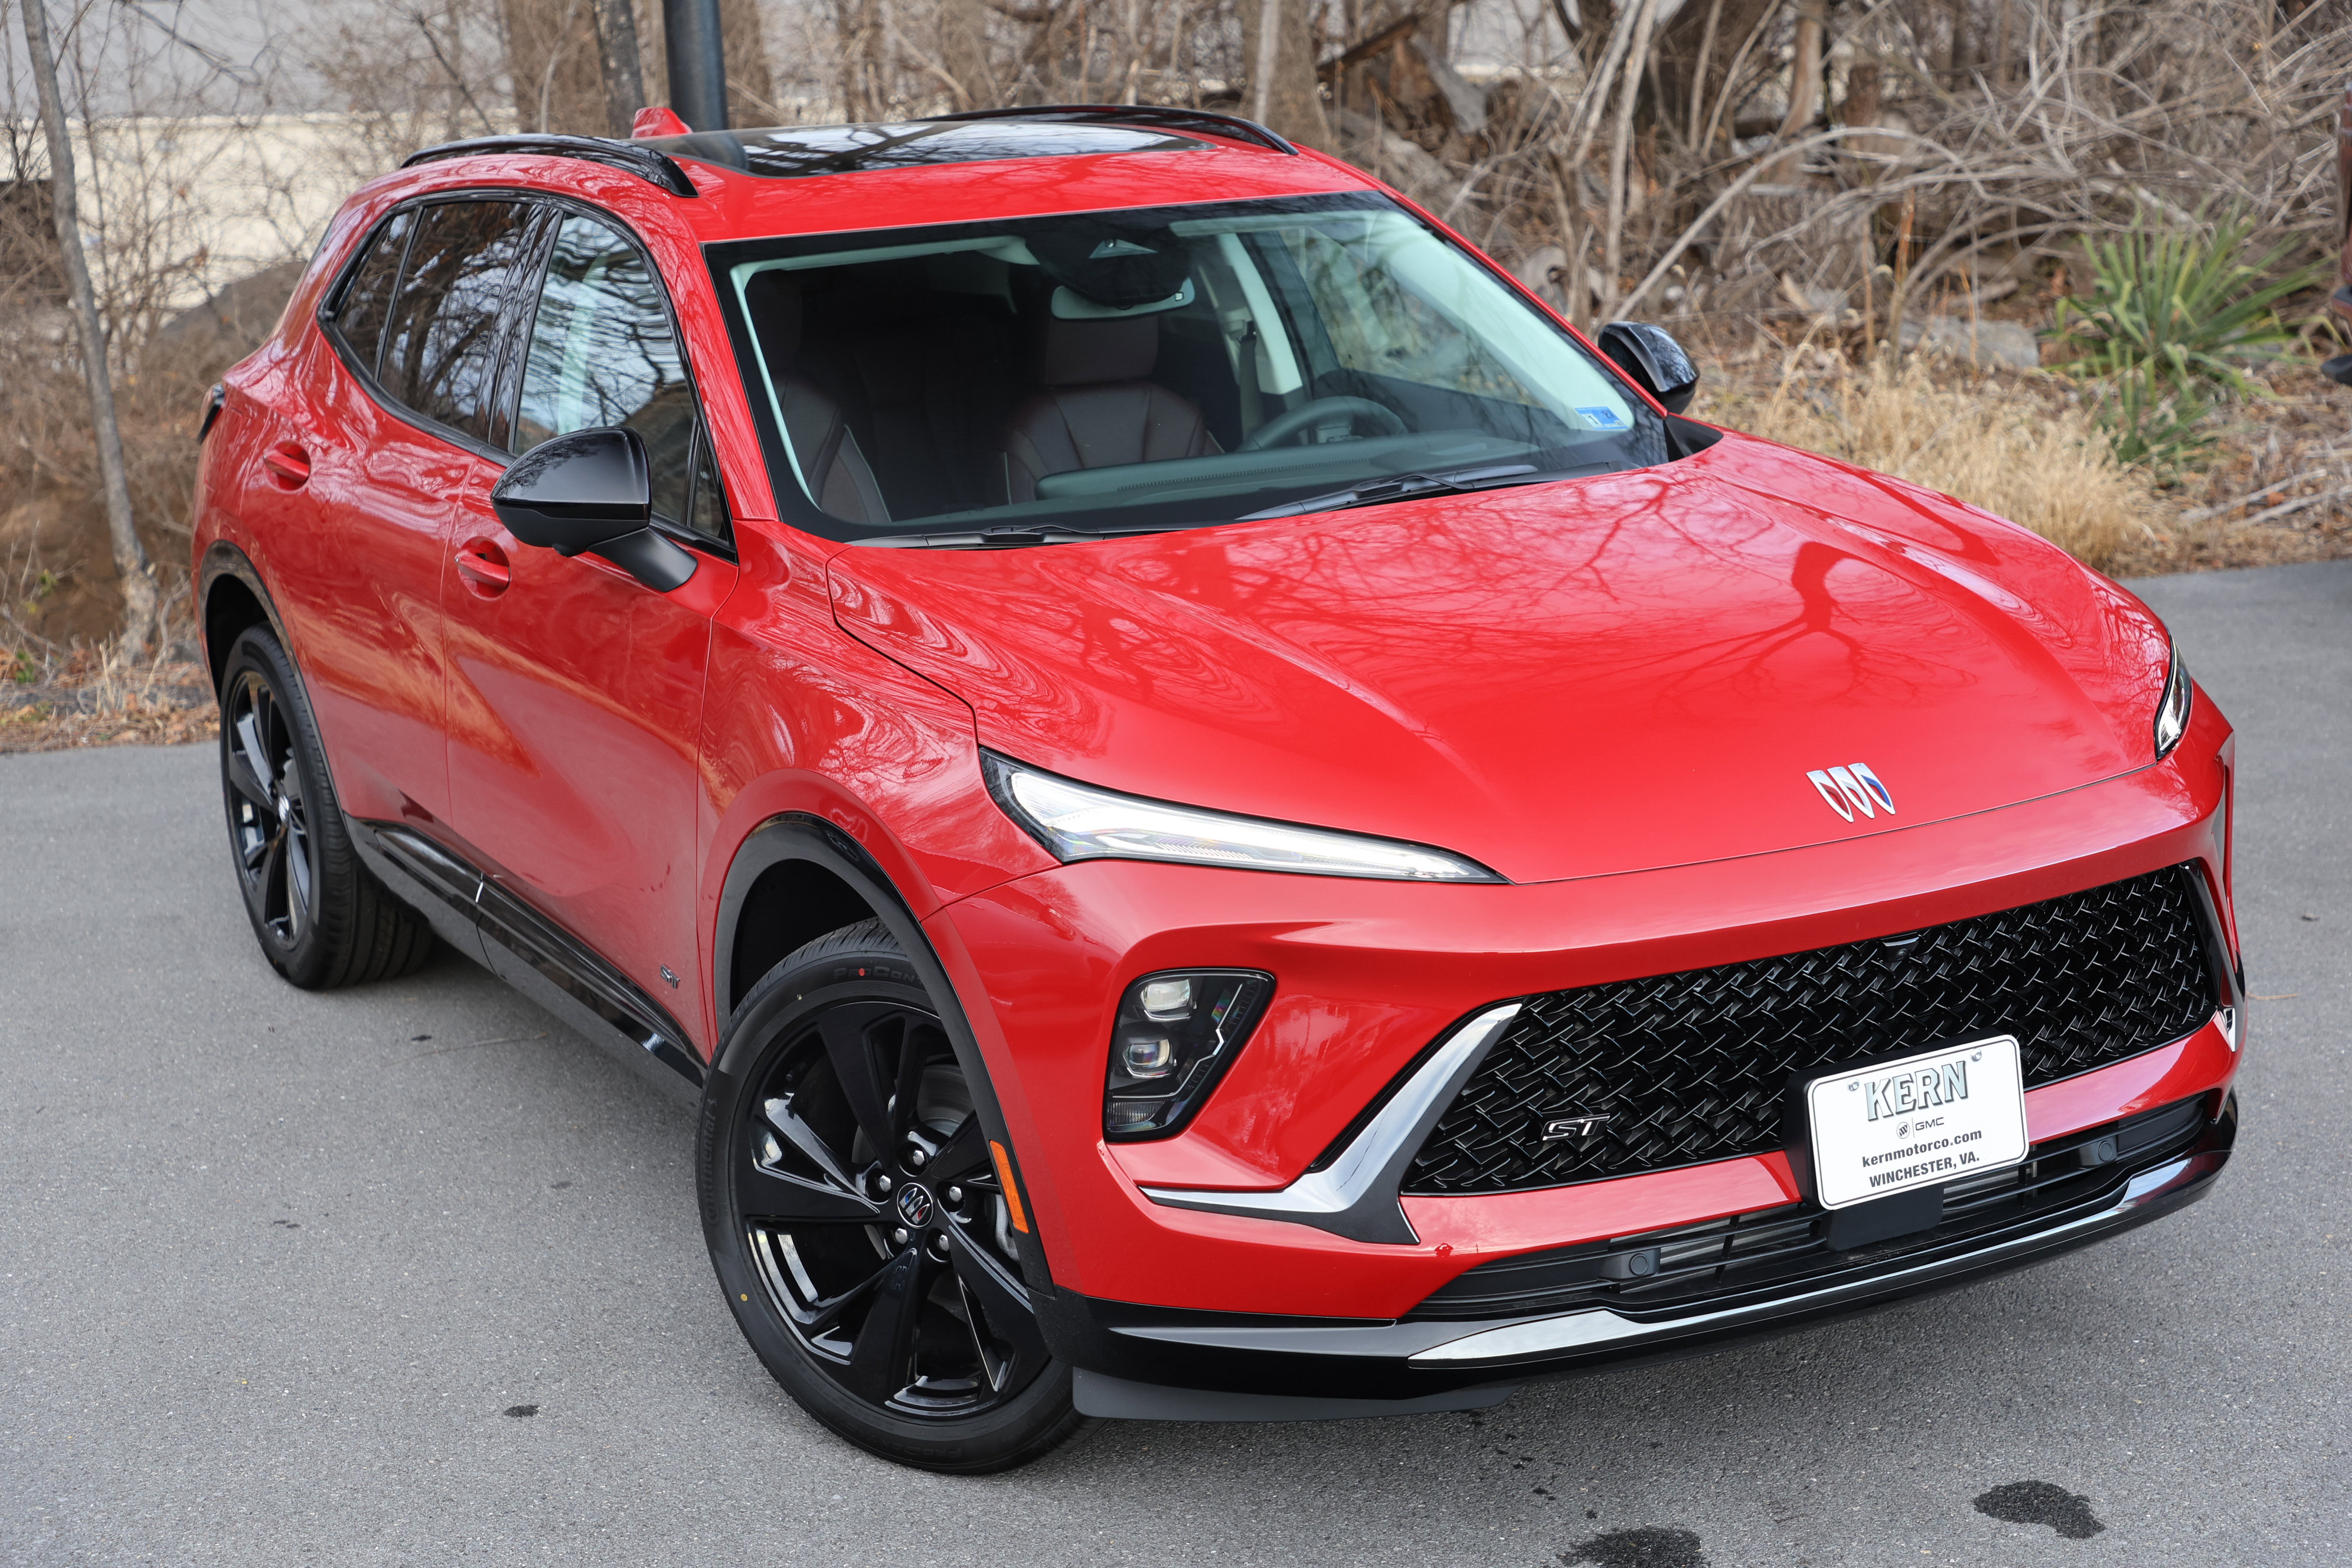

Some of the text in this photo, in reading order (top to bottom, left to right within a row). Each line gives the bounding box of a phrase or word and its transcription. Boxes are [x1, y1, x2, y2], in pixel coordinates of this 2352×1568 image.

[1864, 1060, 1969, 1122] KERN
[1541, 1113, 1611, 1141] ST
[1915, 1116, 1945, 1131] GMC
[1862, 1130, 1982, 1168] kernmotorco.com
[1869, 1151, 1979, 1188] WINCHESTER, VA.
